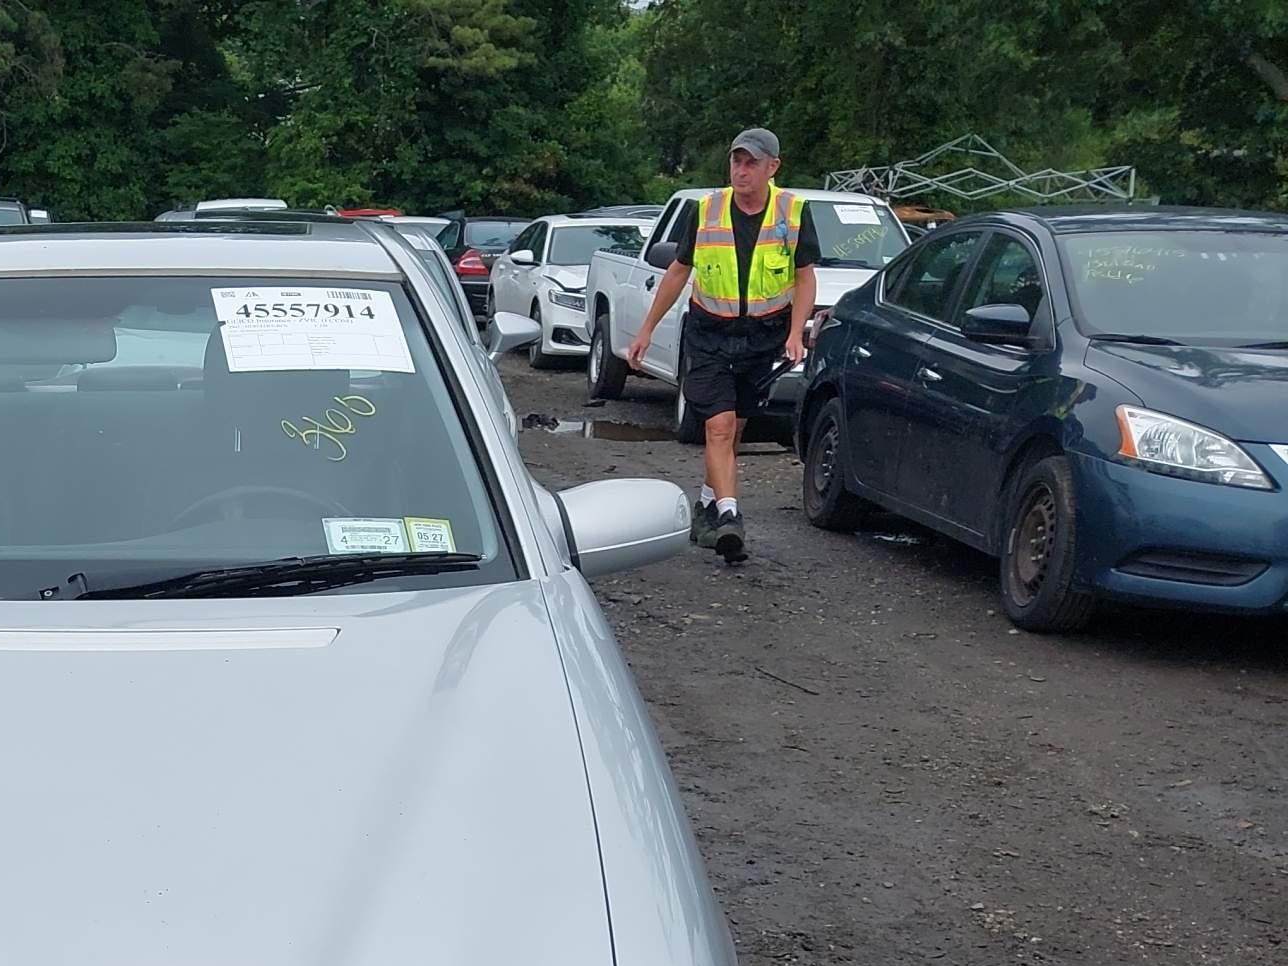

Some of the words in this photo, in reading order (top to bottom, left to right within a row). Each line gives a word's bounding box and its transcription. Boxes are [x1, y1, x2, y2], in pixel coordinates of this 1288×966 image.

[236, 303, 376, 319] 45557914
[340, 535, 349, 545] 4
[382, 535, 399, 545] 27
[417, 532, 429, 540] 05
[432, 533, 444, 541] 27
